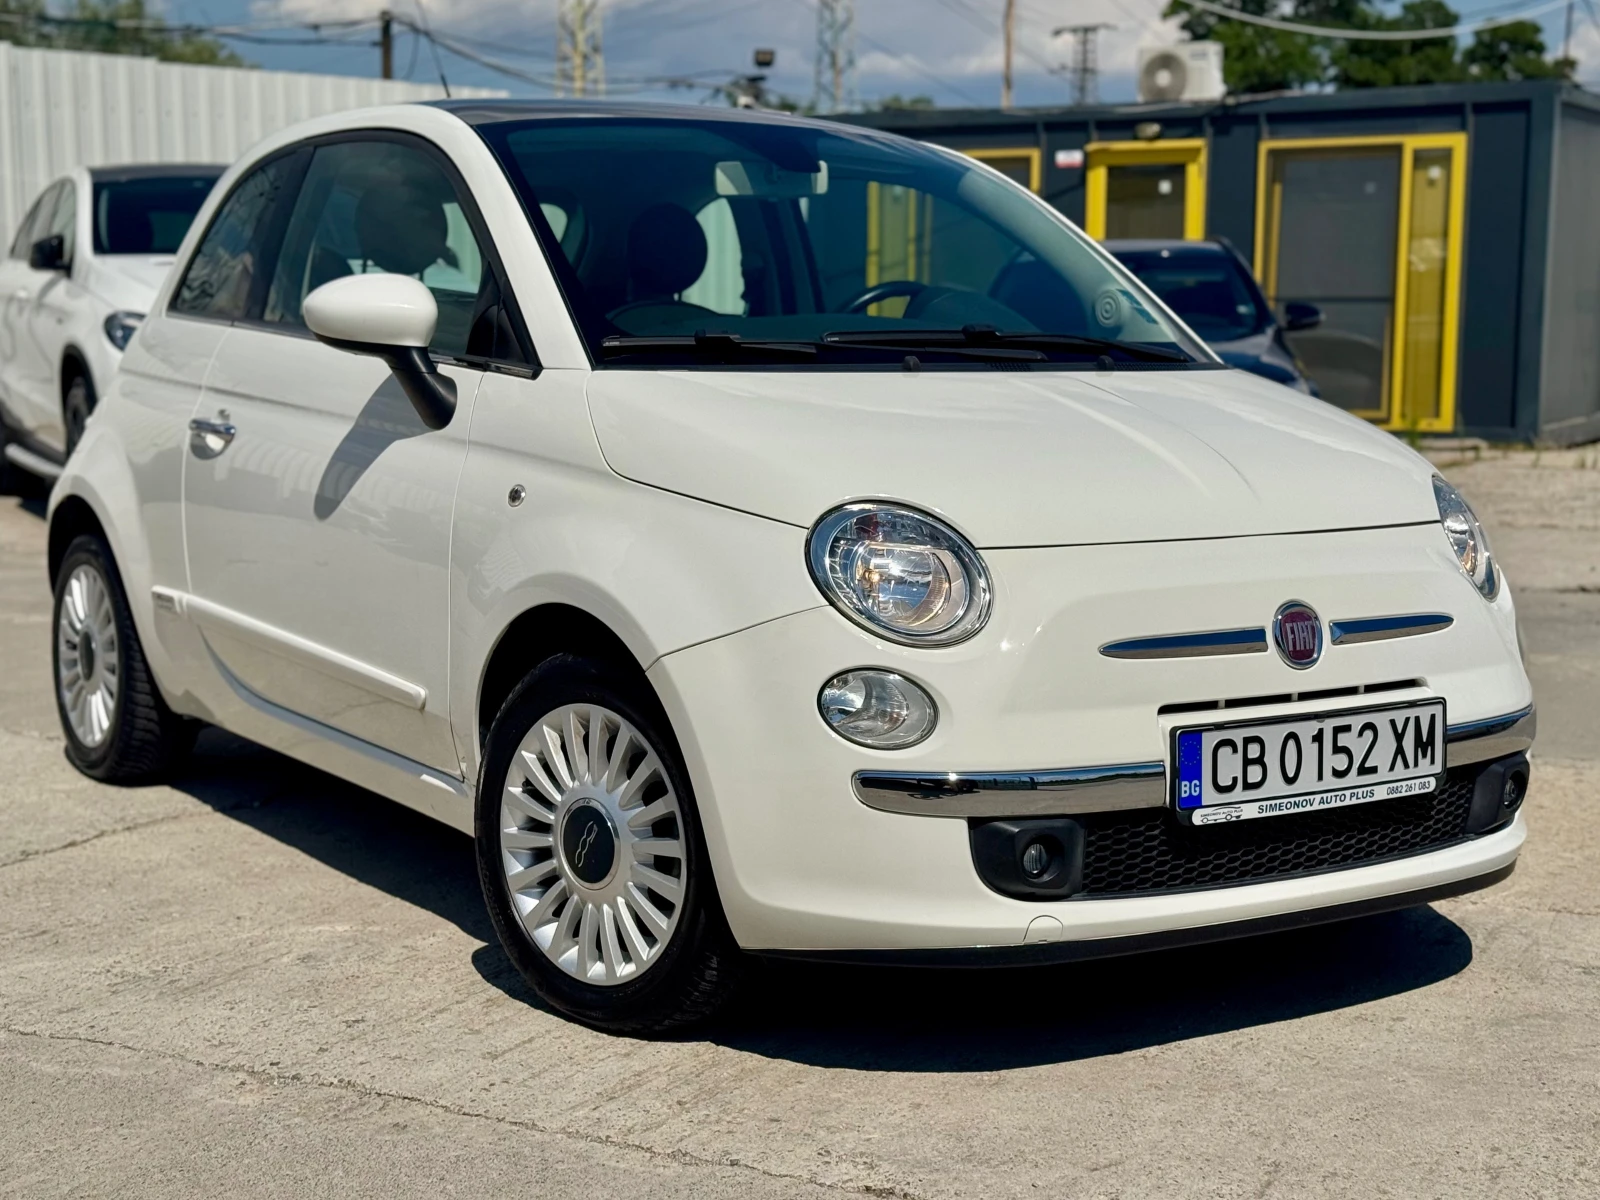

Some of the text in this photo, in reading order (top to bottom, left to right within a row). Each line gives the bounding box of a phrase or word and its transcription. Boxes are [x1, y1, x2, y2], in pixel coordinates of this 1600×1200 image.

[1285, 620, 1314, 652] FIAT
[1211, 713, 1436, 794] CB 0152 XM
[1181, 779, 1201, 798] BG
[1257, 780, 1431, 814] SIMEONOV AUTO PLUS 0882 261 083
